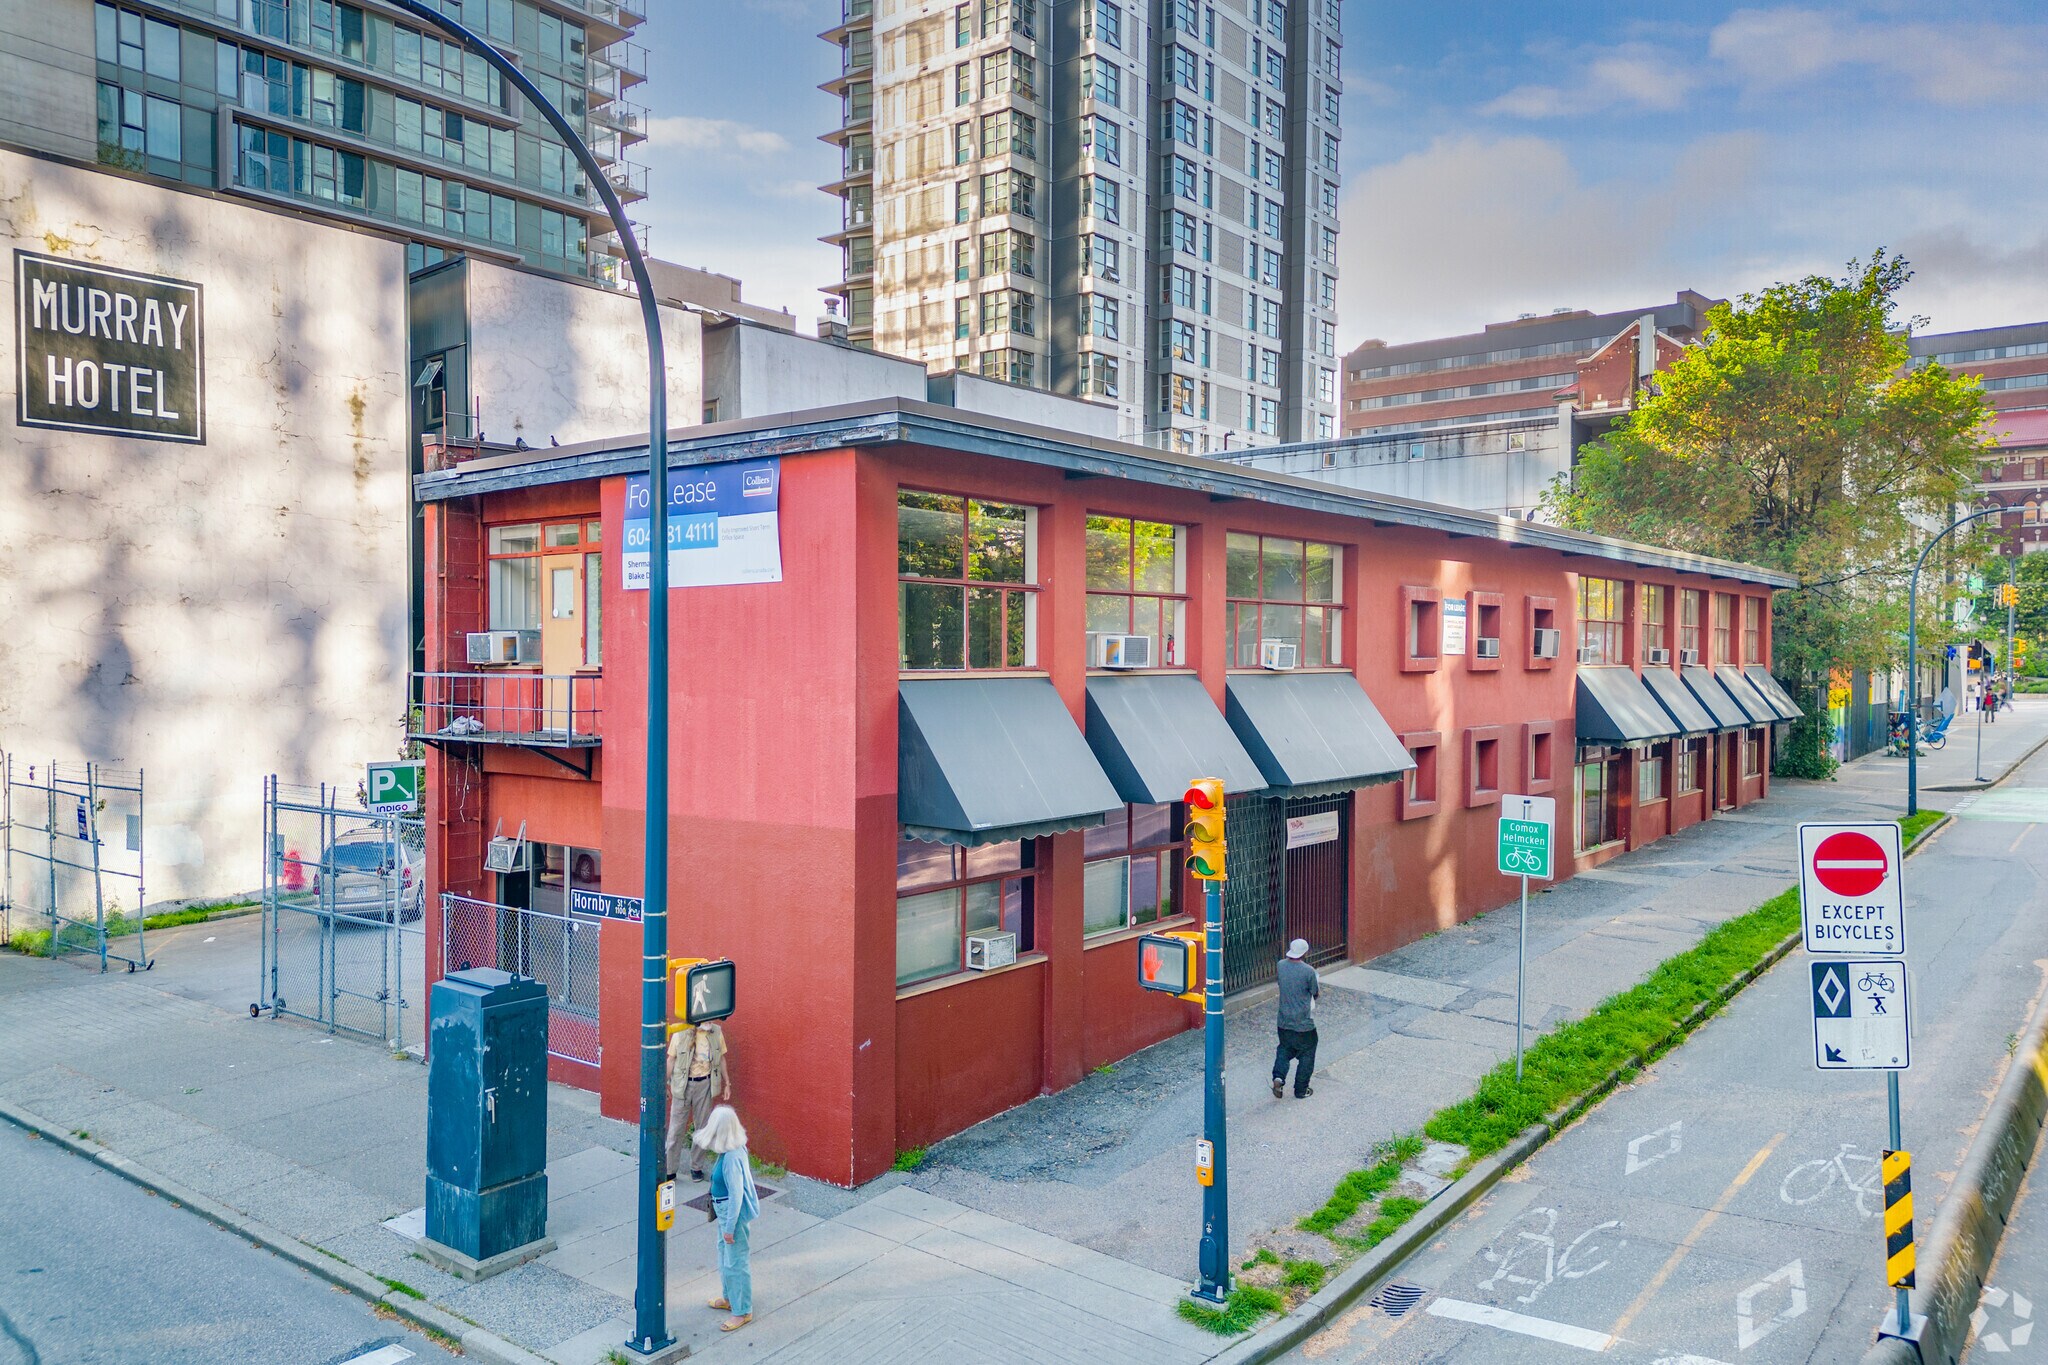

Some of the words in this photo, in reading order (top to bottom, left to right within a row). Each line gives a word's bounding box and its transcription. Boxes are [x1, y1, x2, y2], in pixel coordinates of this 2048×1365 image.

[33, 278, 188, 350] MURRAY
[47, 355, 180, 420] HOTEL
[746, 475, 770, 486] Colliers
[629, 483, 650, 509] Fo
[668, 525, 681, 543] 81
[685, 522, 714, 542] 4111
[372, 769, 396, 802] P
[376, 804, 408, 813] INDIGO
[1510, 822, 1539, 833] Comox
[1503, 833, 1545, 846] Helmcken
[574, 893, 611, 916] Hornby
[1822, 905, 1885, 920] EXCEPT
[1815, 925, 1895, 940] BICYCLES
